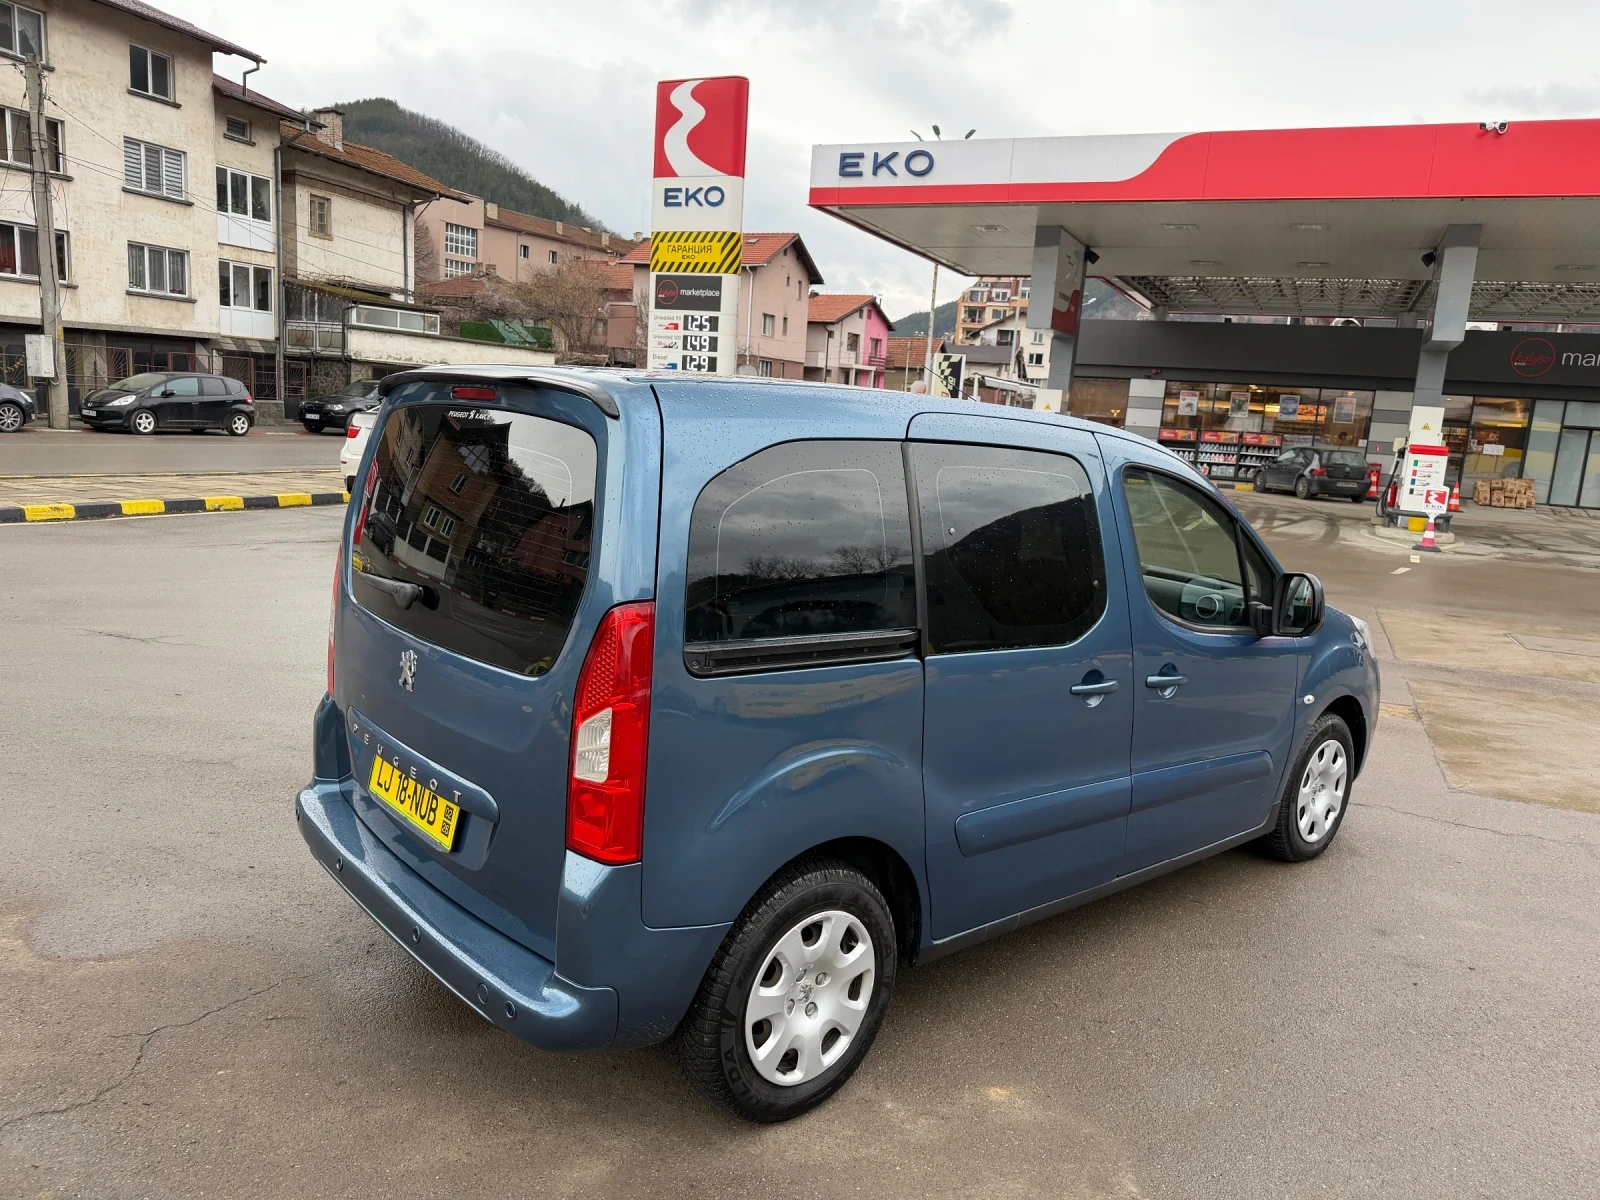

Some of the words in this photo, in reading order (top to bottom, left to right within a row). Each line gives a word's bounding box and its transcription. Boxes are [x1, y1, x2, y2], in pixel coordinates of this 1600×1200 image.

[839, 149, 934, 177] EKO
[663, 185, 725, 208] EKO
[667, 244, 712, 255] ГАРАНЦИЯ
[680, 287, 720, 299] marketplace
[687, 315, 710, 332] 1.25
[687, 335, 710, 352] 1.49
[652, 353, 668, 361] Diesel
[686, 355, 709, 372] 1.29
[353, 723, 462, 803] PEUGEOT
